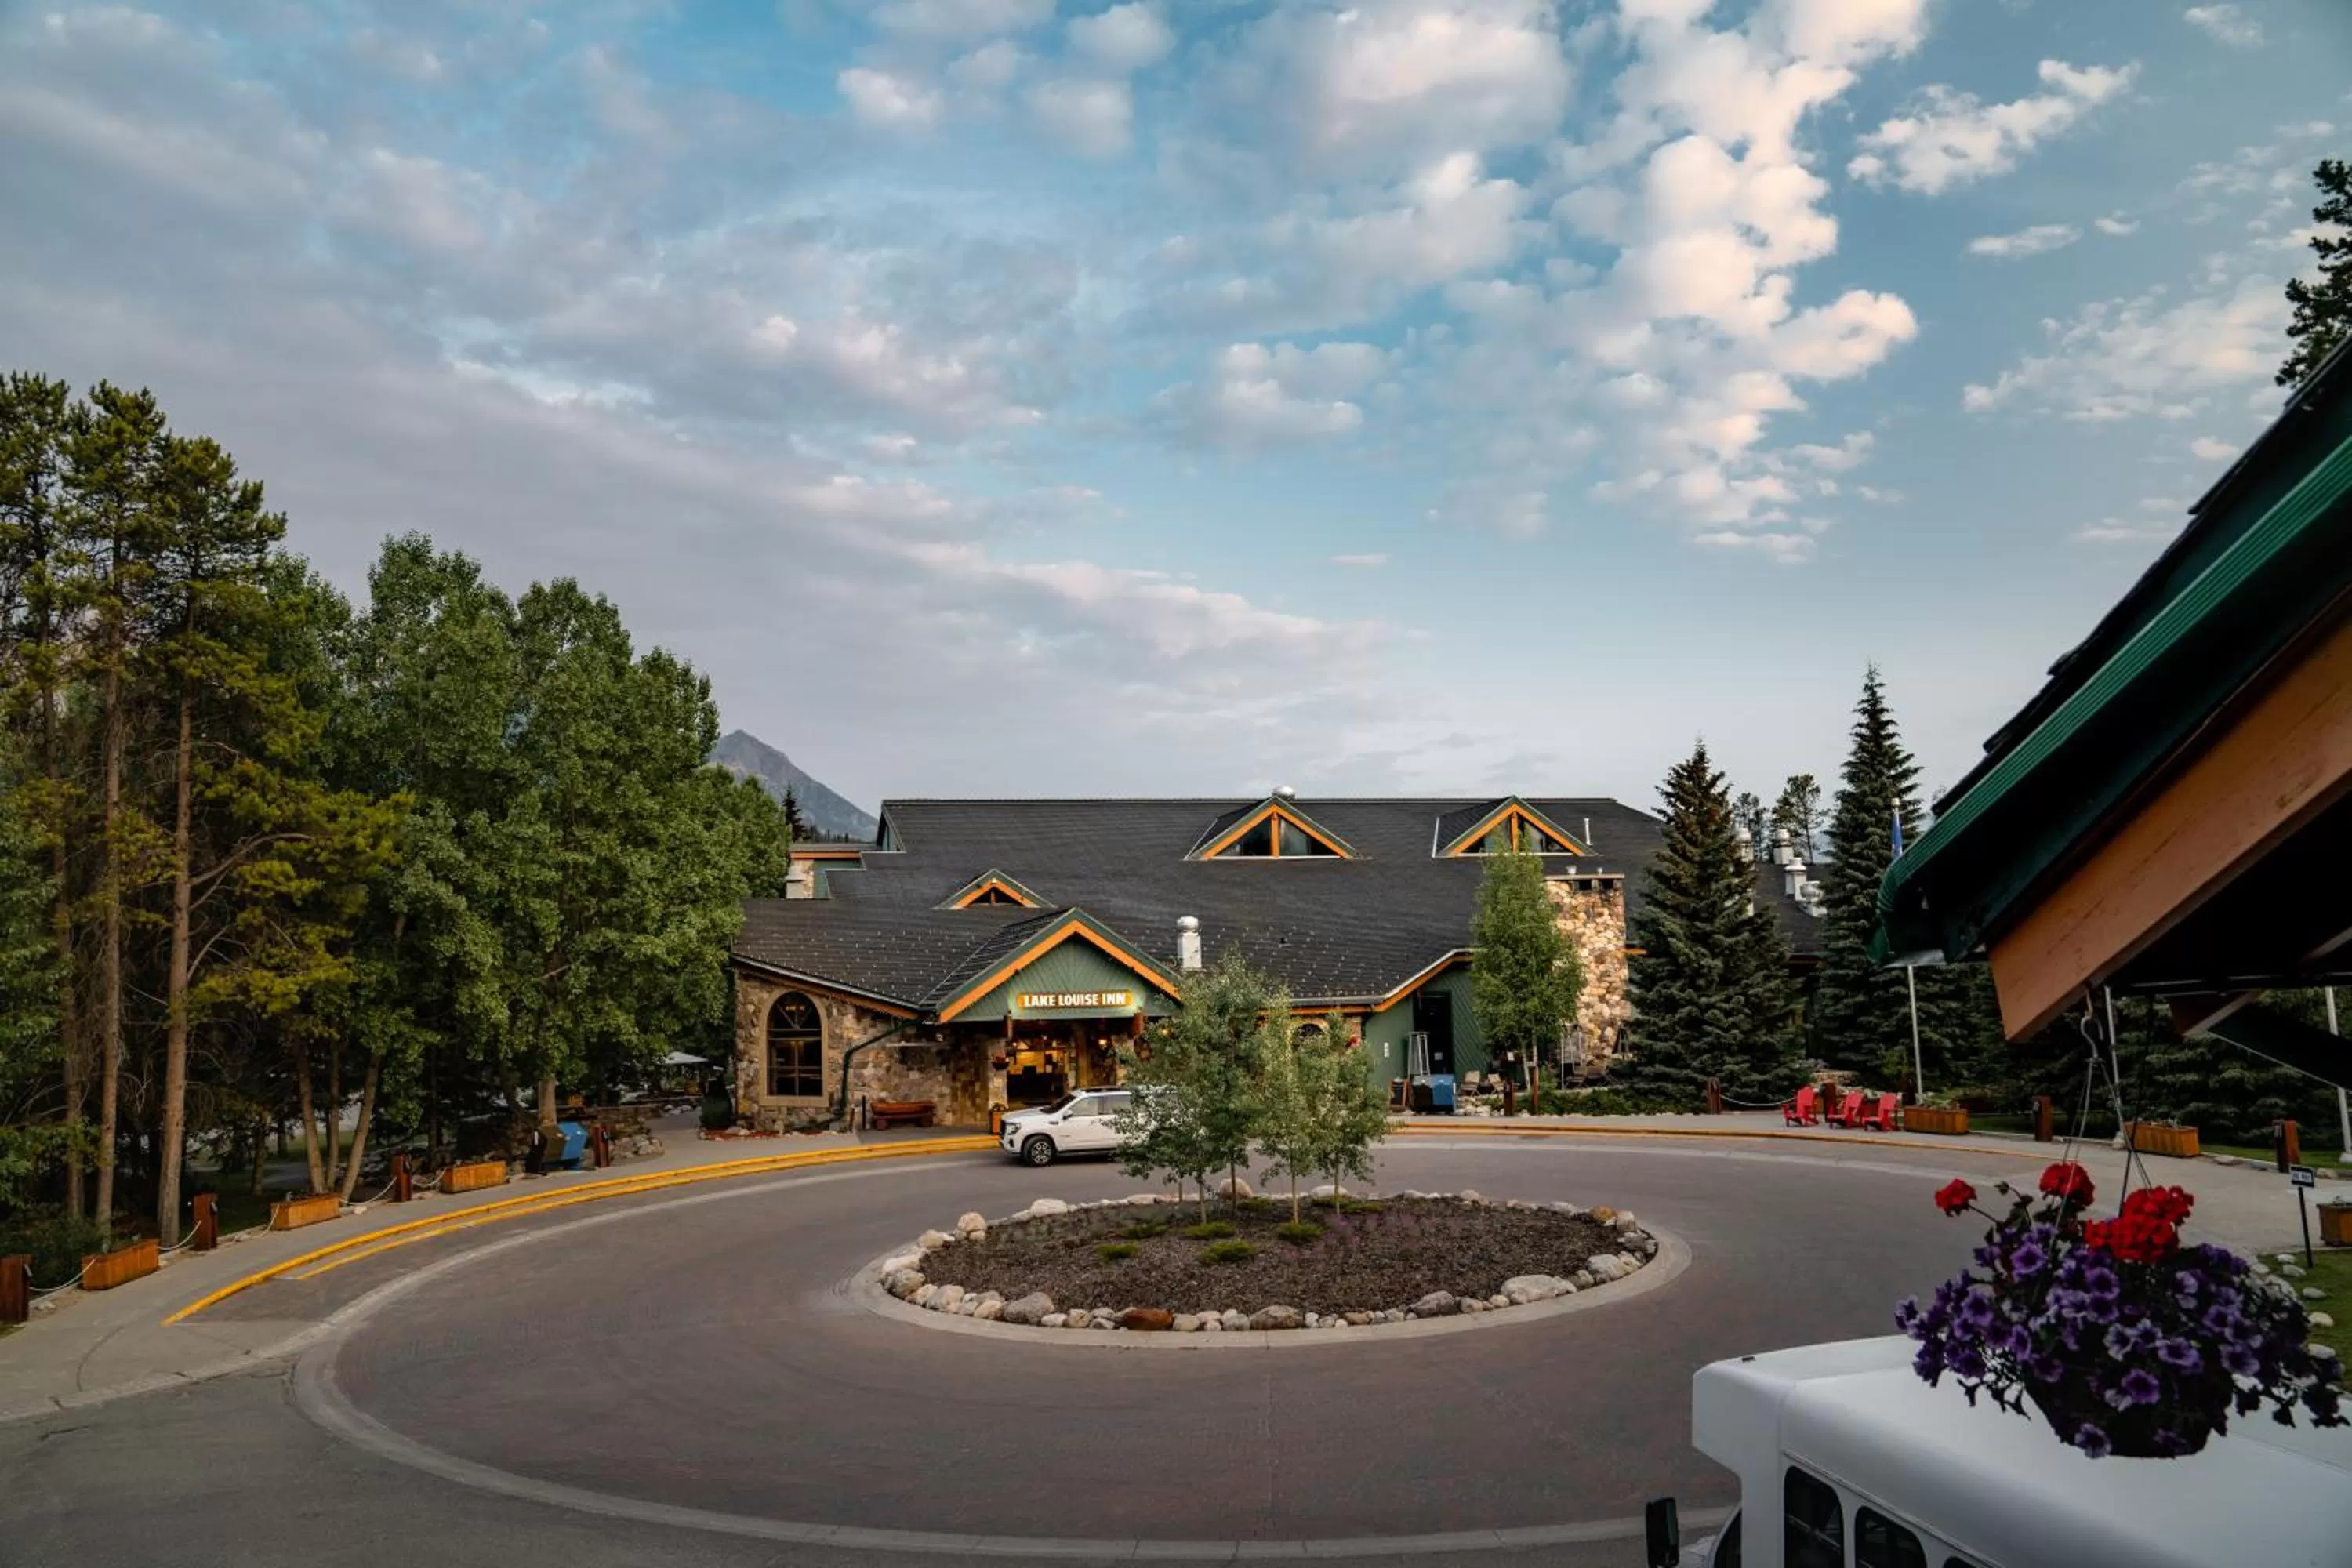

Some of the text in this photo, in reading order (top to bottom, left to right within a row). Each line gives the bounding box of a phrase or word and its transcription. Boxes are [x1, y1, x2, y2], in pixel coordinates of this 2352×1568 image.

[1024, 992, 1127, 1007] LAKE LOUISE INN
